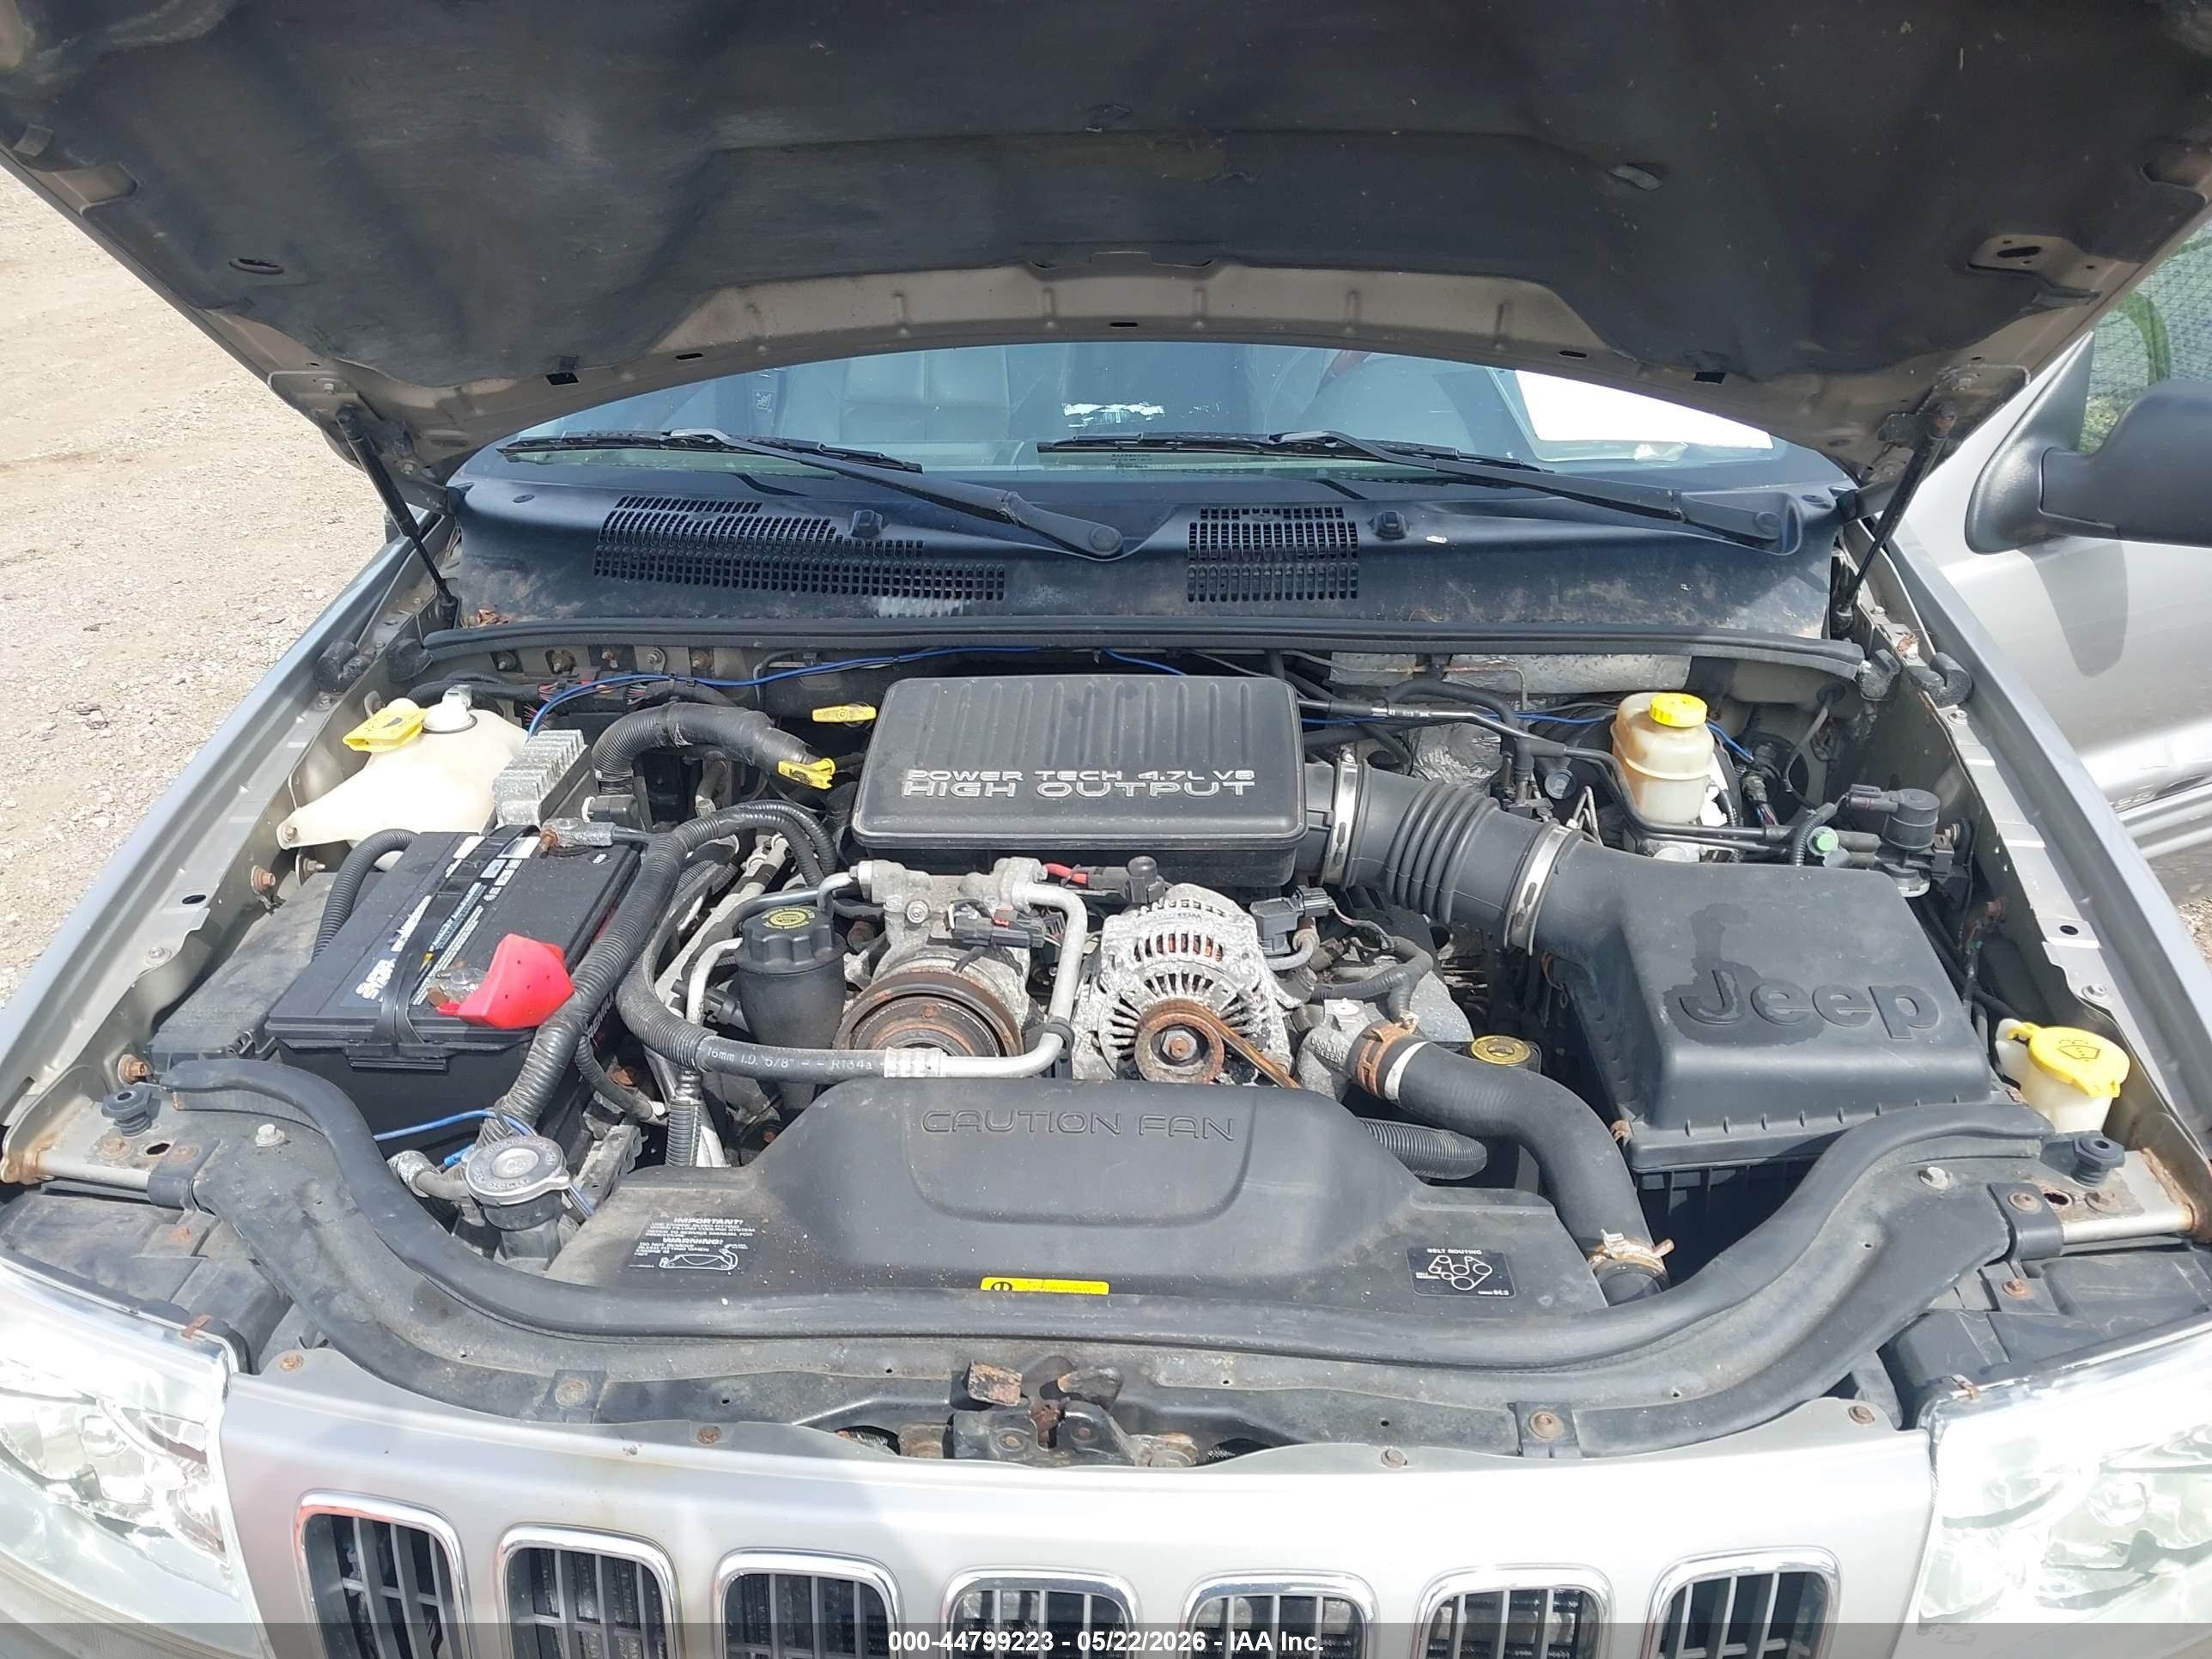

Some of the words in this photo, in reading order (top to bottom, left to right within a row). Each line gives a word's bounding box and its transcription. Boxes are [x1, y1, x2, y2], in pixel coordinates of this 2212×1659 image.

[906, 769, 1024, 781] POWER
[1034, 770, 1123, 781] TECH
[1137, 770, 1206, 781] 4.7L
[1212, 769, 1255, 781] V8
[902, 781, 1018, 798] HIGH
[1036, 781, 1256, 798] OUTPUT
[1679, 969, 1941, 1039] Jeep
[707, 1047, 735, 1062] 16mm
[921, 1109, 1121, 1134] CAUTION
[1139, 1114, 1235, 1141] FAN
